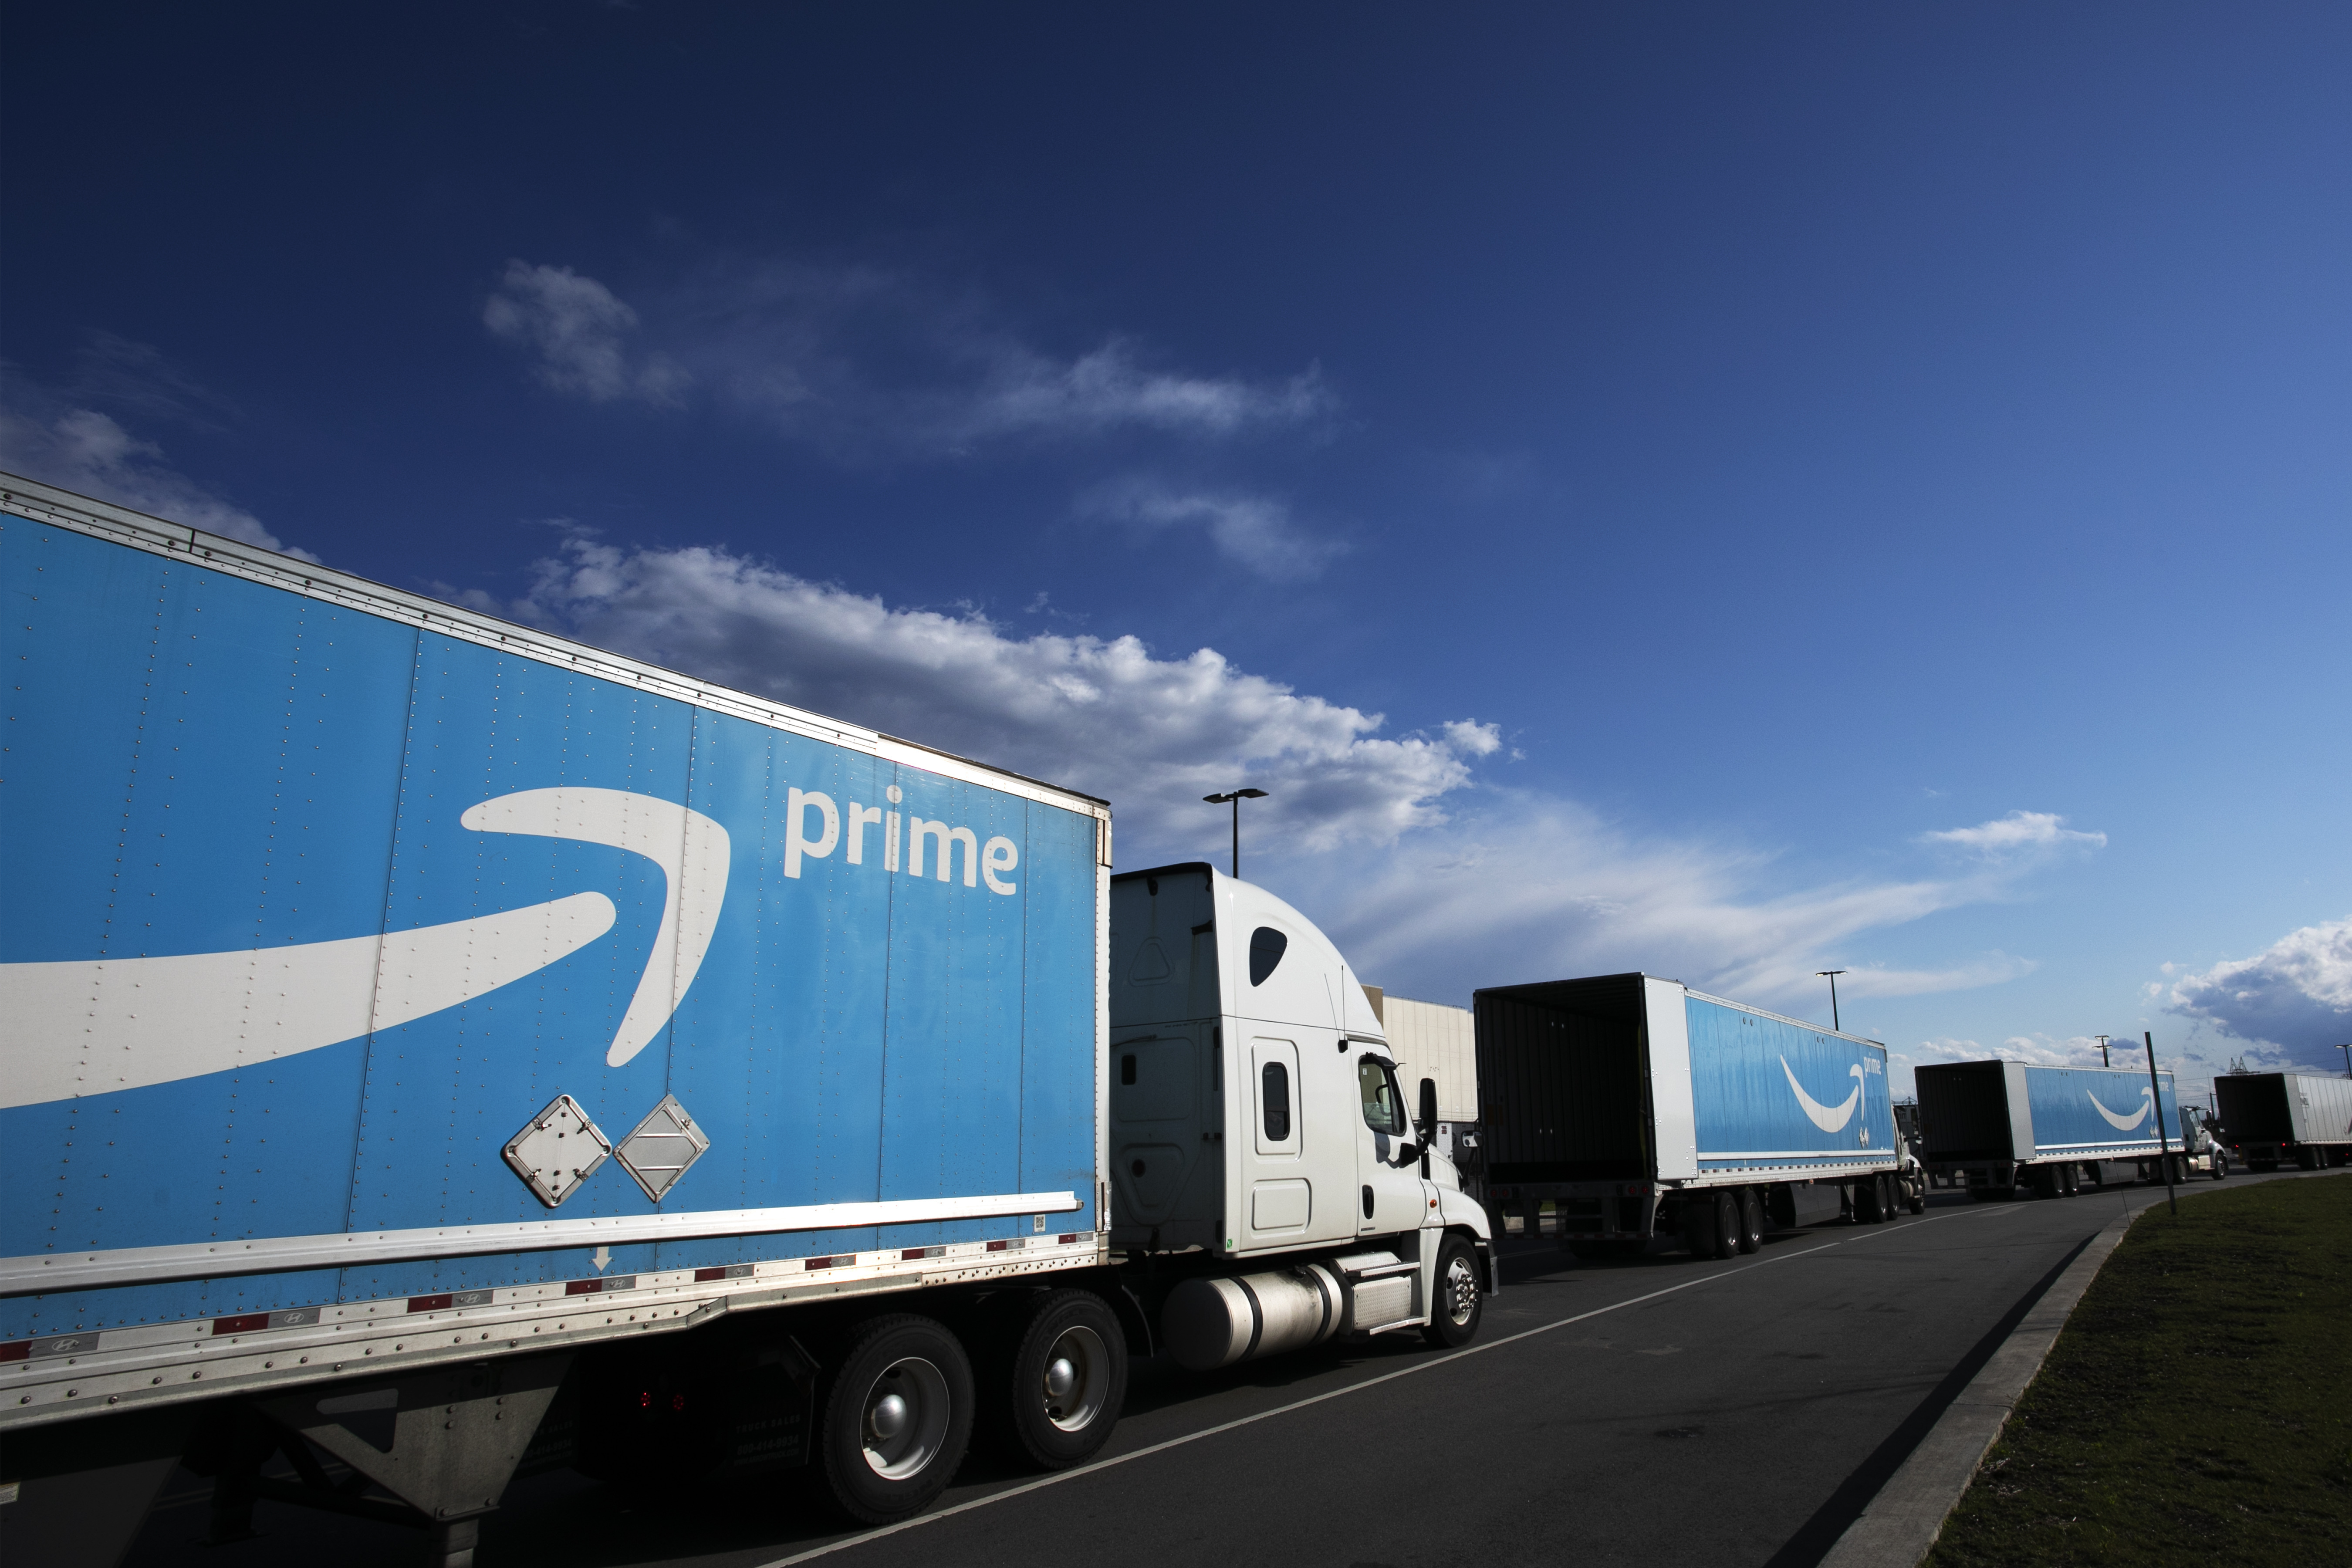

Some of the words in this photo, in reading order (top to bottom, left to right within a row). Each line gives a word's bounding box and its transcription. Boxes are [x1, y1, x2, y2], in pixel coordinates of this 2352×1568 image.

[784, 785, 1018, 895] prime
[1863, 1052, 1881, 1078] prime
[2157, 1078, 2169, 1092] ime
[736, 1420, 767, 1434] TRUCK
[770, 1414, 801, 1427] SALES
[523, 1438, 571, 1459] 00-414-9934
[737, 1434, 799, 1456] 800-414-9934
